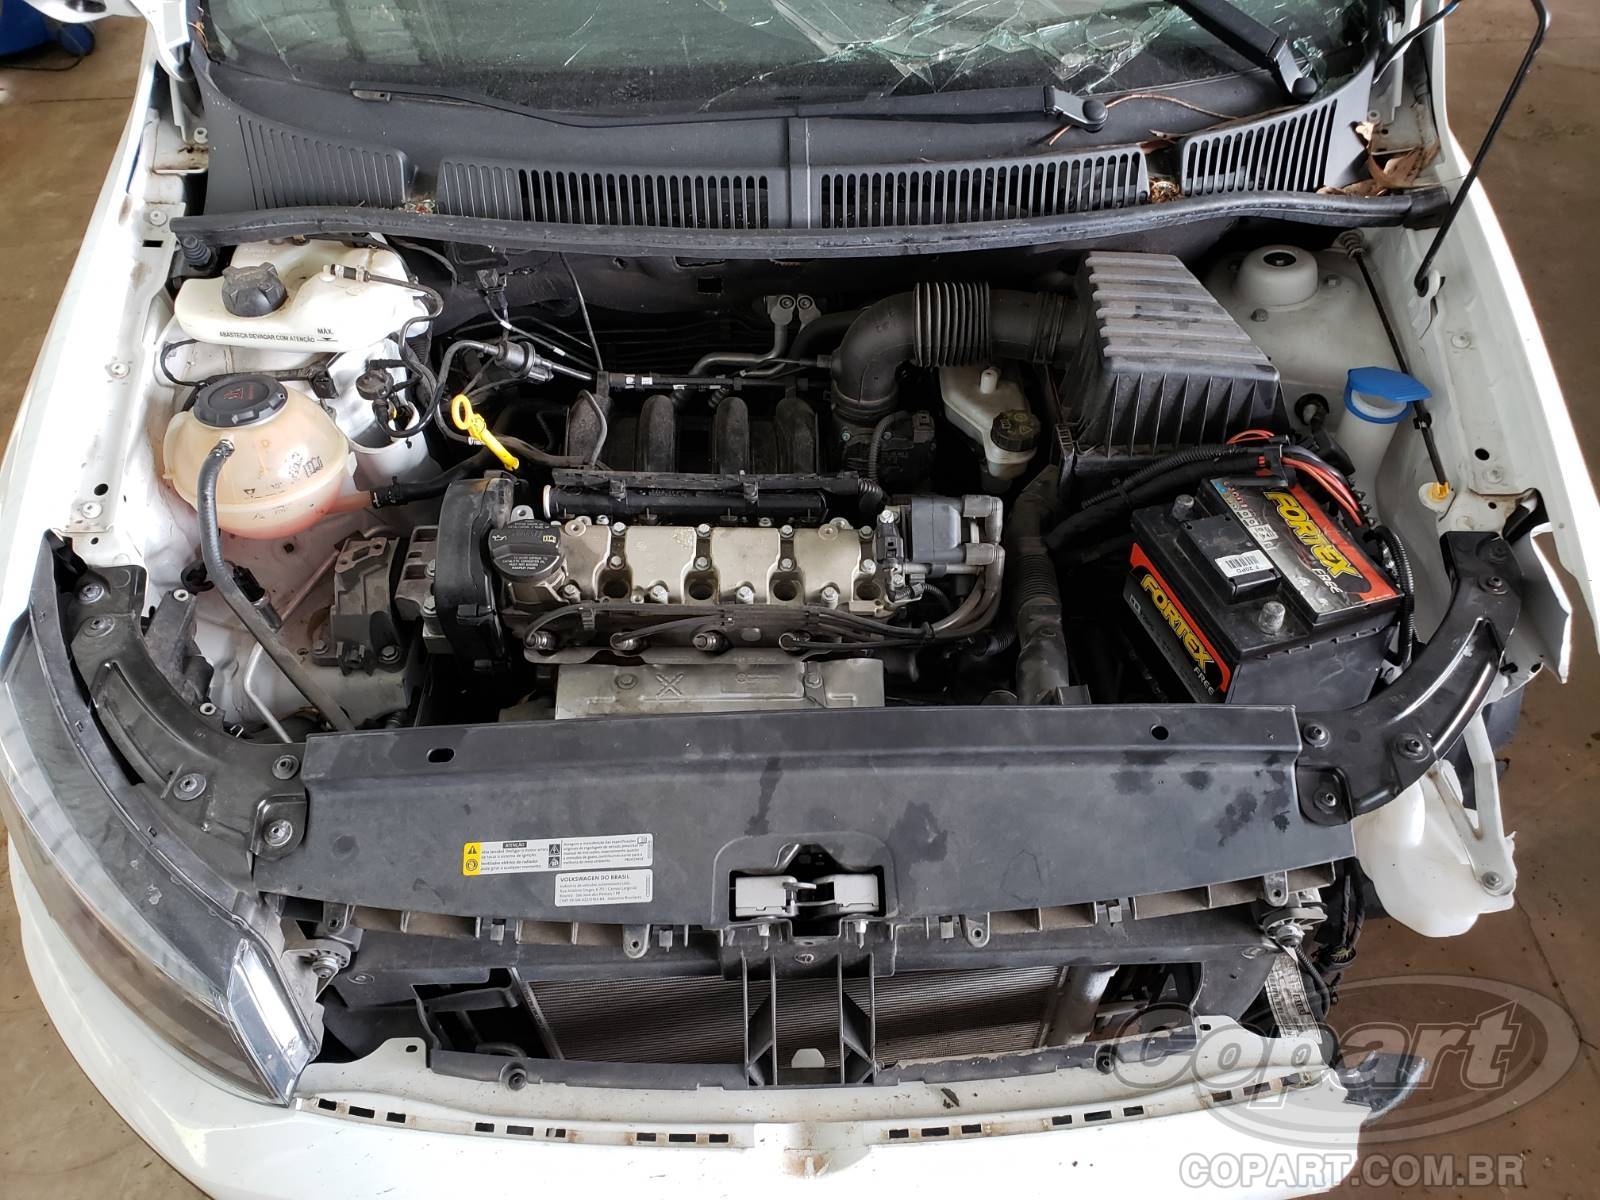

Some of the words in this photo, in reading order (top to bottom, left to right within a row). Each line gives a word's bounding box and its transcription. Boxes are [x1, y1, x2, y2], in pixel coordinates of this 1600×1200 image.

[1263, 491, 1363, 580] FORTEX
[1140, 574, 1215, 674] FORTEX
[1193, 666, 1216, 696] FREE
[611, 872, 630, 880] BRASIL
